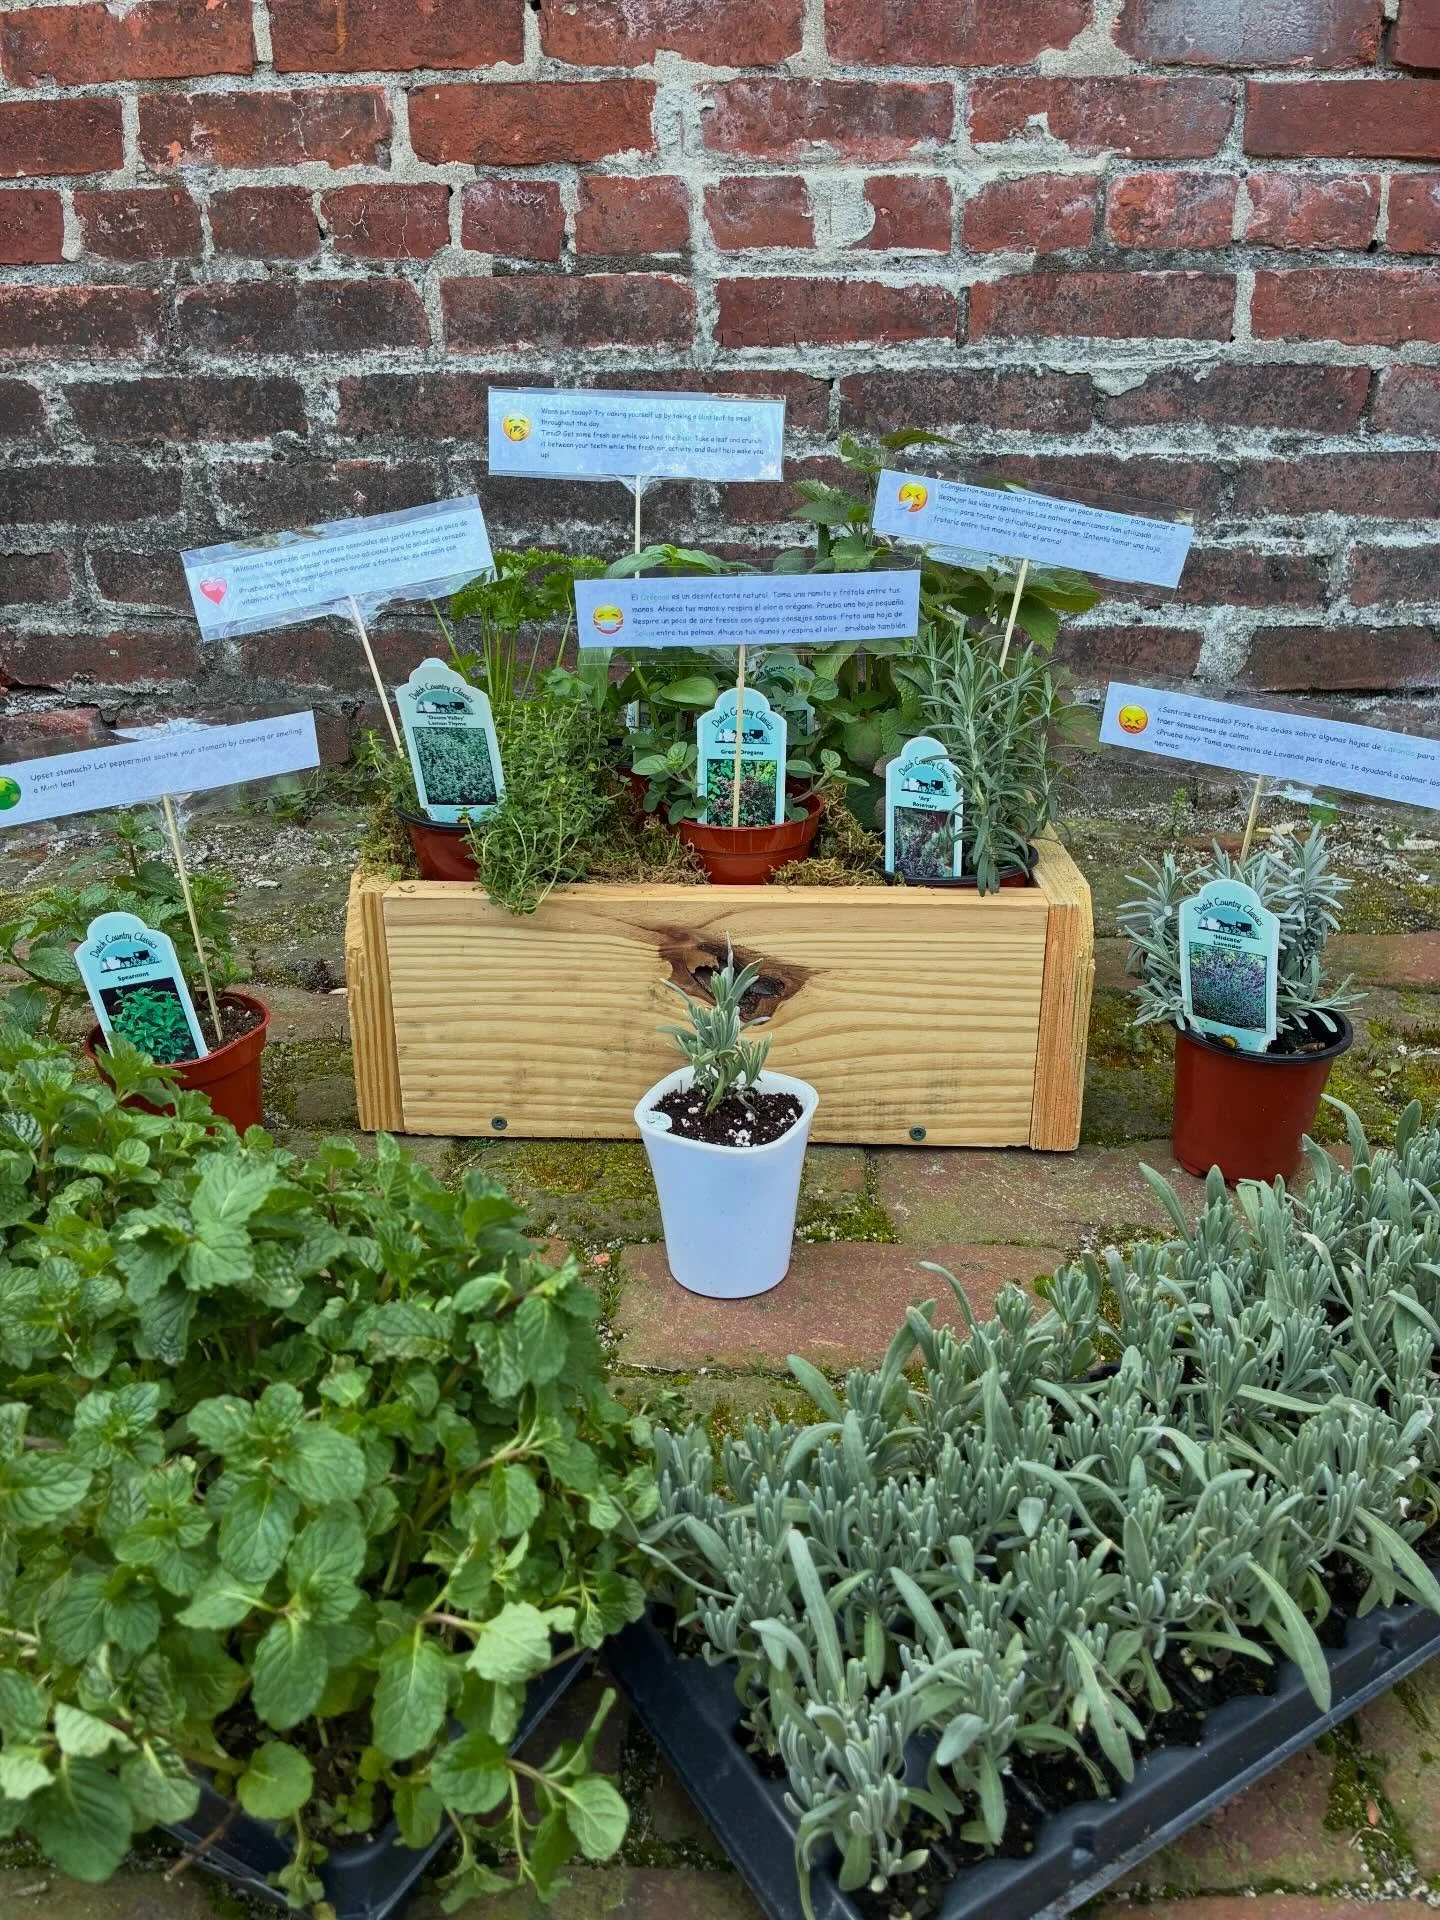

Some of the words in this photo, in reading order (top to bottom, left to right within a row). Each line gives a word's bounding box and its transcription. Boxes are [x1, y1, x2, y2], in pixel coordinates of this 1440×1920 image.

[857, 600, 873, 608] hoja
[876, 611, 892, 619] hoja
[408, 686, 426, 700] Dutch
[425, 682, 450, 693] Country
[712, 711, 730, 728] Dutch
[756, 710, 774, 730] Classics
[1217, 728, 1227, 736] de
[1233, 719, 1254, 729] Frote
[1294, 730, 1316, 738] sobre
[1317, 733, 1347, 743] algunas
[1347, 737, 1369, 748] hojas
[1370, 742, 1382, 750] de
[1416, 752, 1435, 760] para
[29, 771, 53, 782] Upset
[55, 764, 92, 776] stomach?
[93, 761, 107, 769] Let
[109, 754, 151, 769] peppermint
[152, 750, 178, 760] soothe
[179, 748, 196, 757] your
[197, 741, 227, 752] stomach
[227, 739, 237, 747] by
[238, 735, 266, 744] chewing
[274, 728, 303, 738] smelling
[898, 760, 914, 776] Dutch
[1262, 747, 1272, 755] de
[1273, 749, 1304, 760] Lavanda
[1304, 755, 1323, 763] para
[1350, 762, 1359, 770] te
[1360, 766, 1393, 776] ayudará
[1400, 773, 1427, 783] calmar
[1428, 777, 1440, 786] los
[39, 782, 58, 792] Mint
[1194, 898, 1214, 916] Dutch
[1214, 897, 1242, 912] Country
[1242, 904, 1264, 927] Classics
[90, 940, 106, 958] Dutch
[105, 932, 132, 944] Country
[134, 932, 158, 950] Classics
[1213, 940, 1242, 950] Lavender
[118, 972, 149, 981] Spearmint
